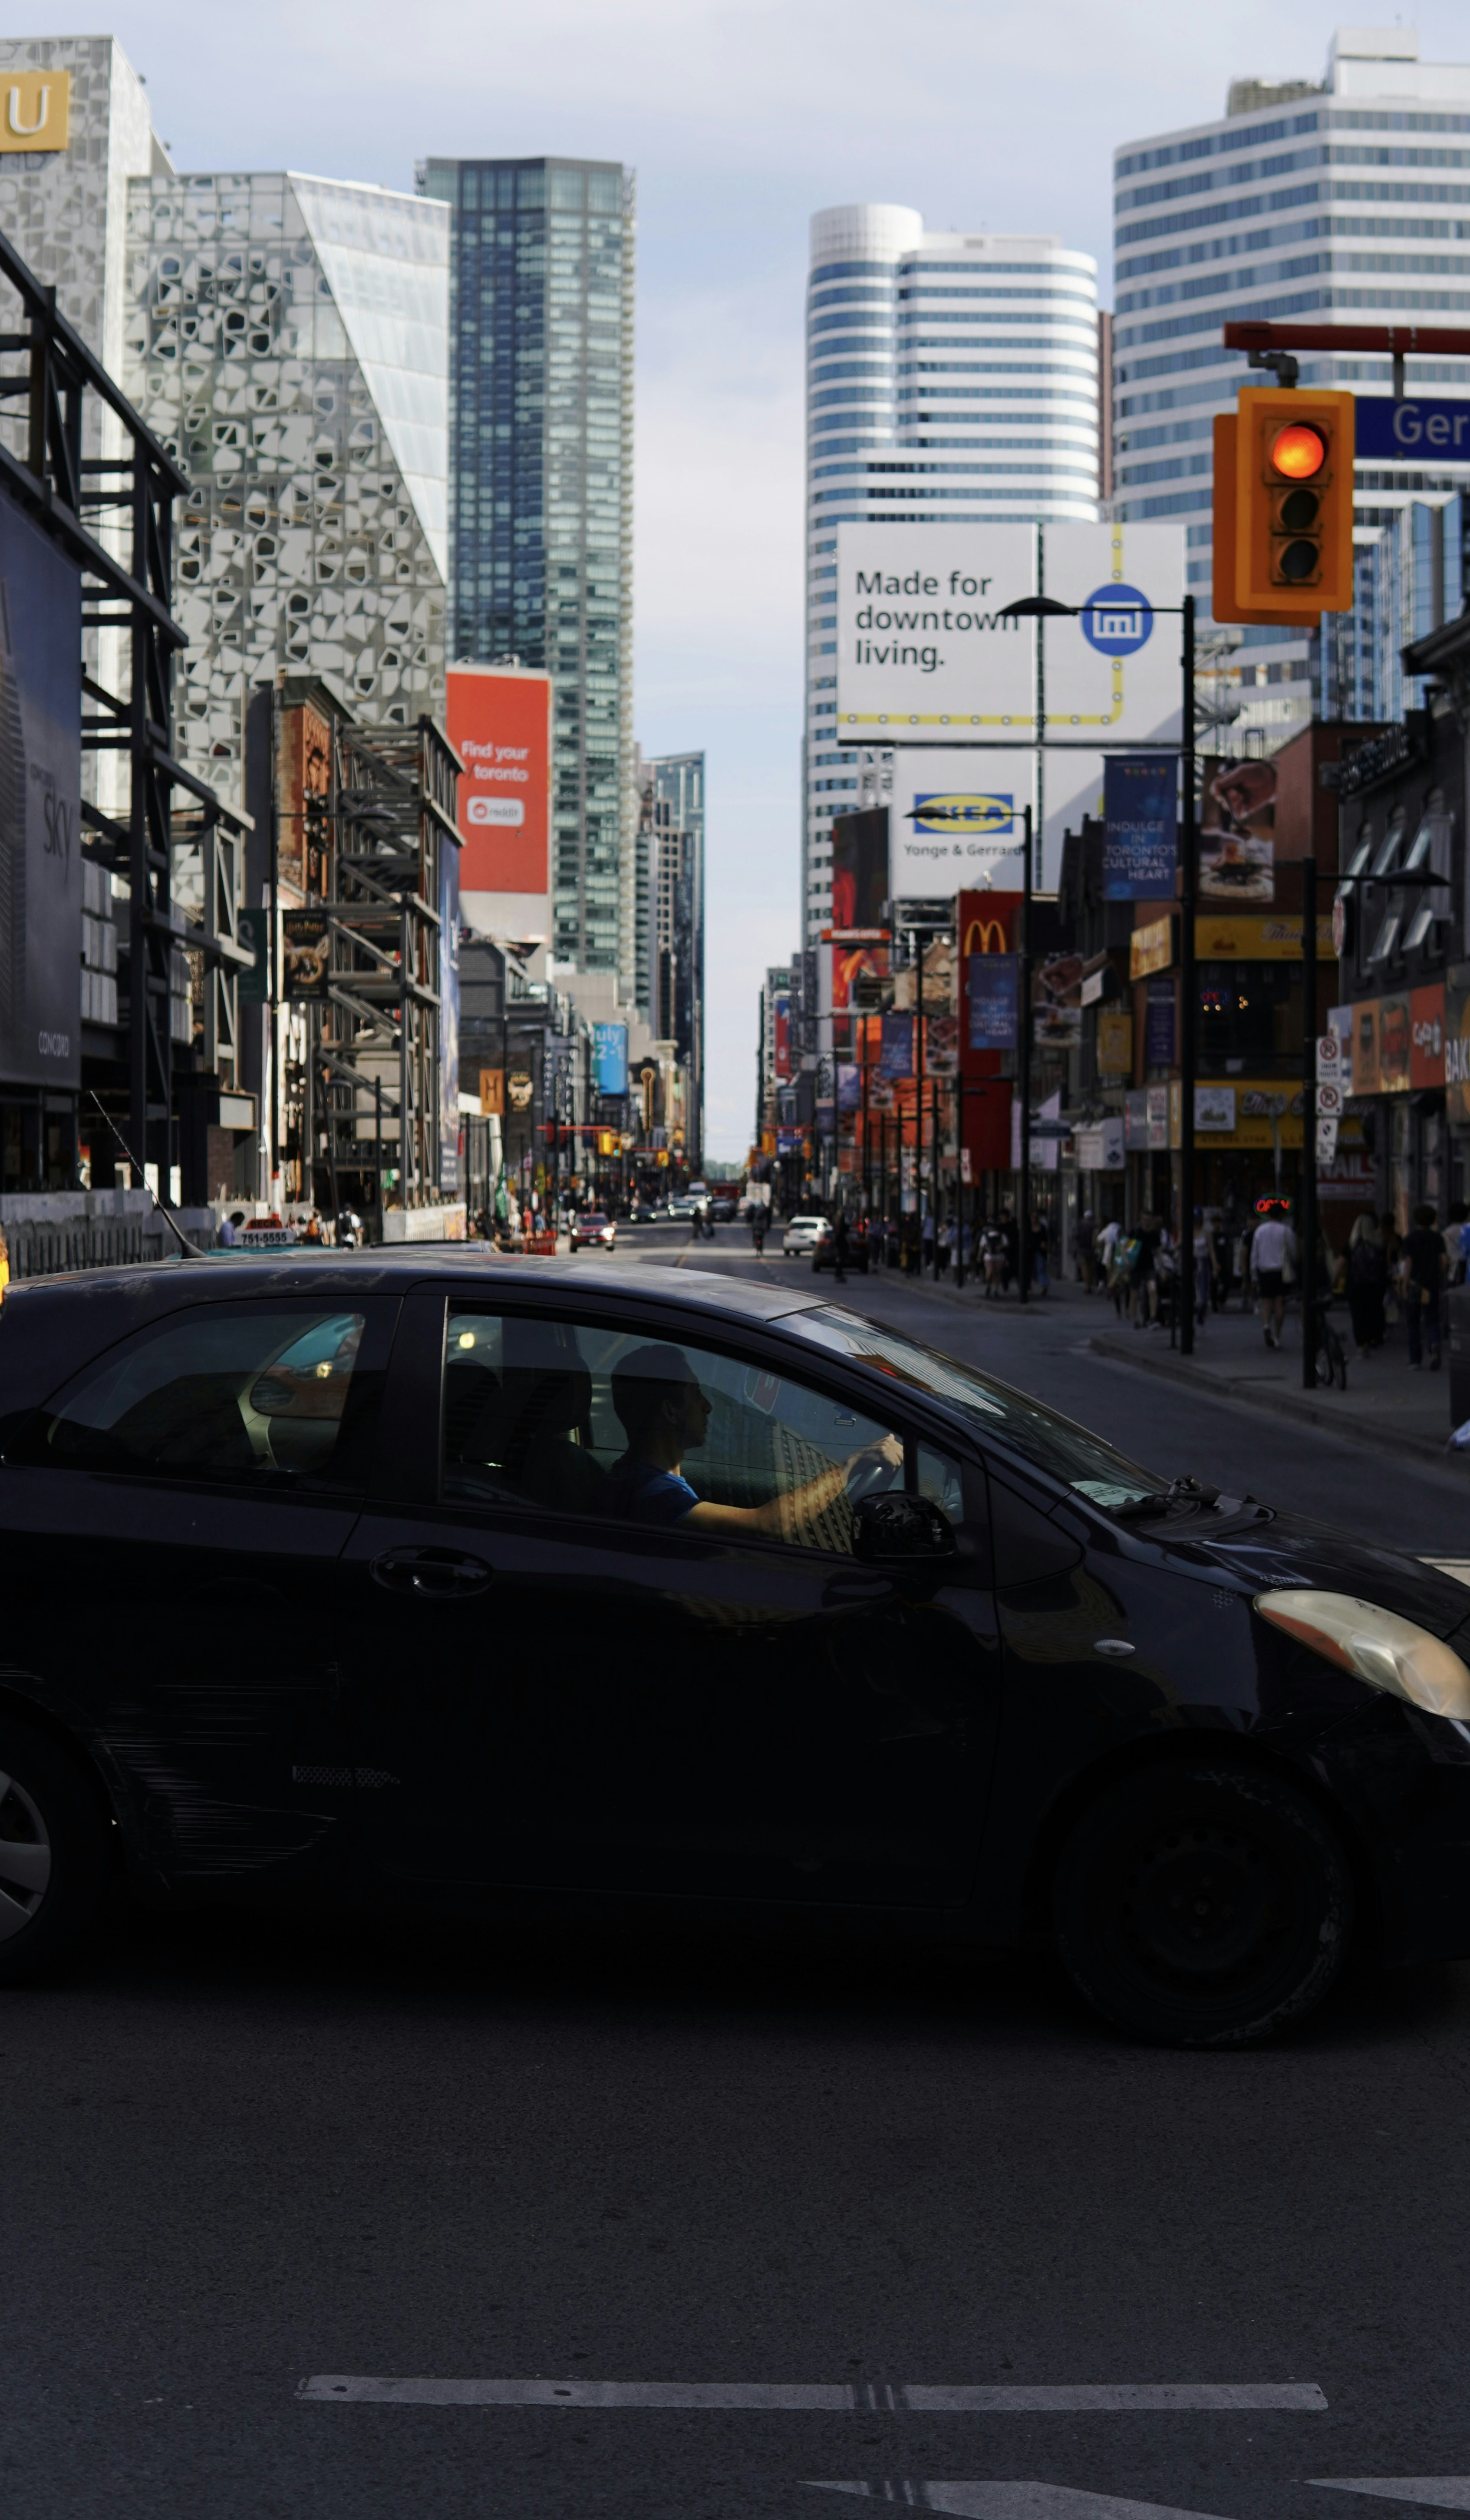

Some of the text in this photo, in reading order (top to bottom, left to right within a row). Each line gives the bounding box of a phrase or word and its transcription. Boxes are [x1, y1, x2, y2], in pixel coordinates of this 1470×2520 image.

[856, 570, 993, 595] Made for
[856, 605, 1019, 630] downtown
[856, 639, 945, 672] living.
[461, 740, 530, 763] Find your
[490, 808, 518, 818] reddit
[1107, 820, 1165, 833] INDULGE
[1131, 833, 1145, 844] IN
[904, 843, 1025, 860] Yonge & Gerrard
[1105, 843, 1177, 858] TORONTO'S
[1101, 856, 1165, 869] CULTURAL
[1127, 867, 1170, 881] HEART
[38, 1030, 69, 1058] CONCORD
[250, 1219, 277, 1229] BECK
[241, 1232, 287, 1244] 751-5555
